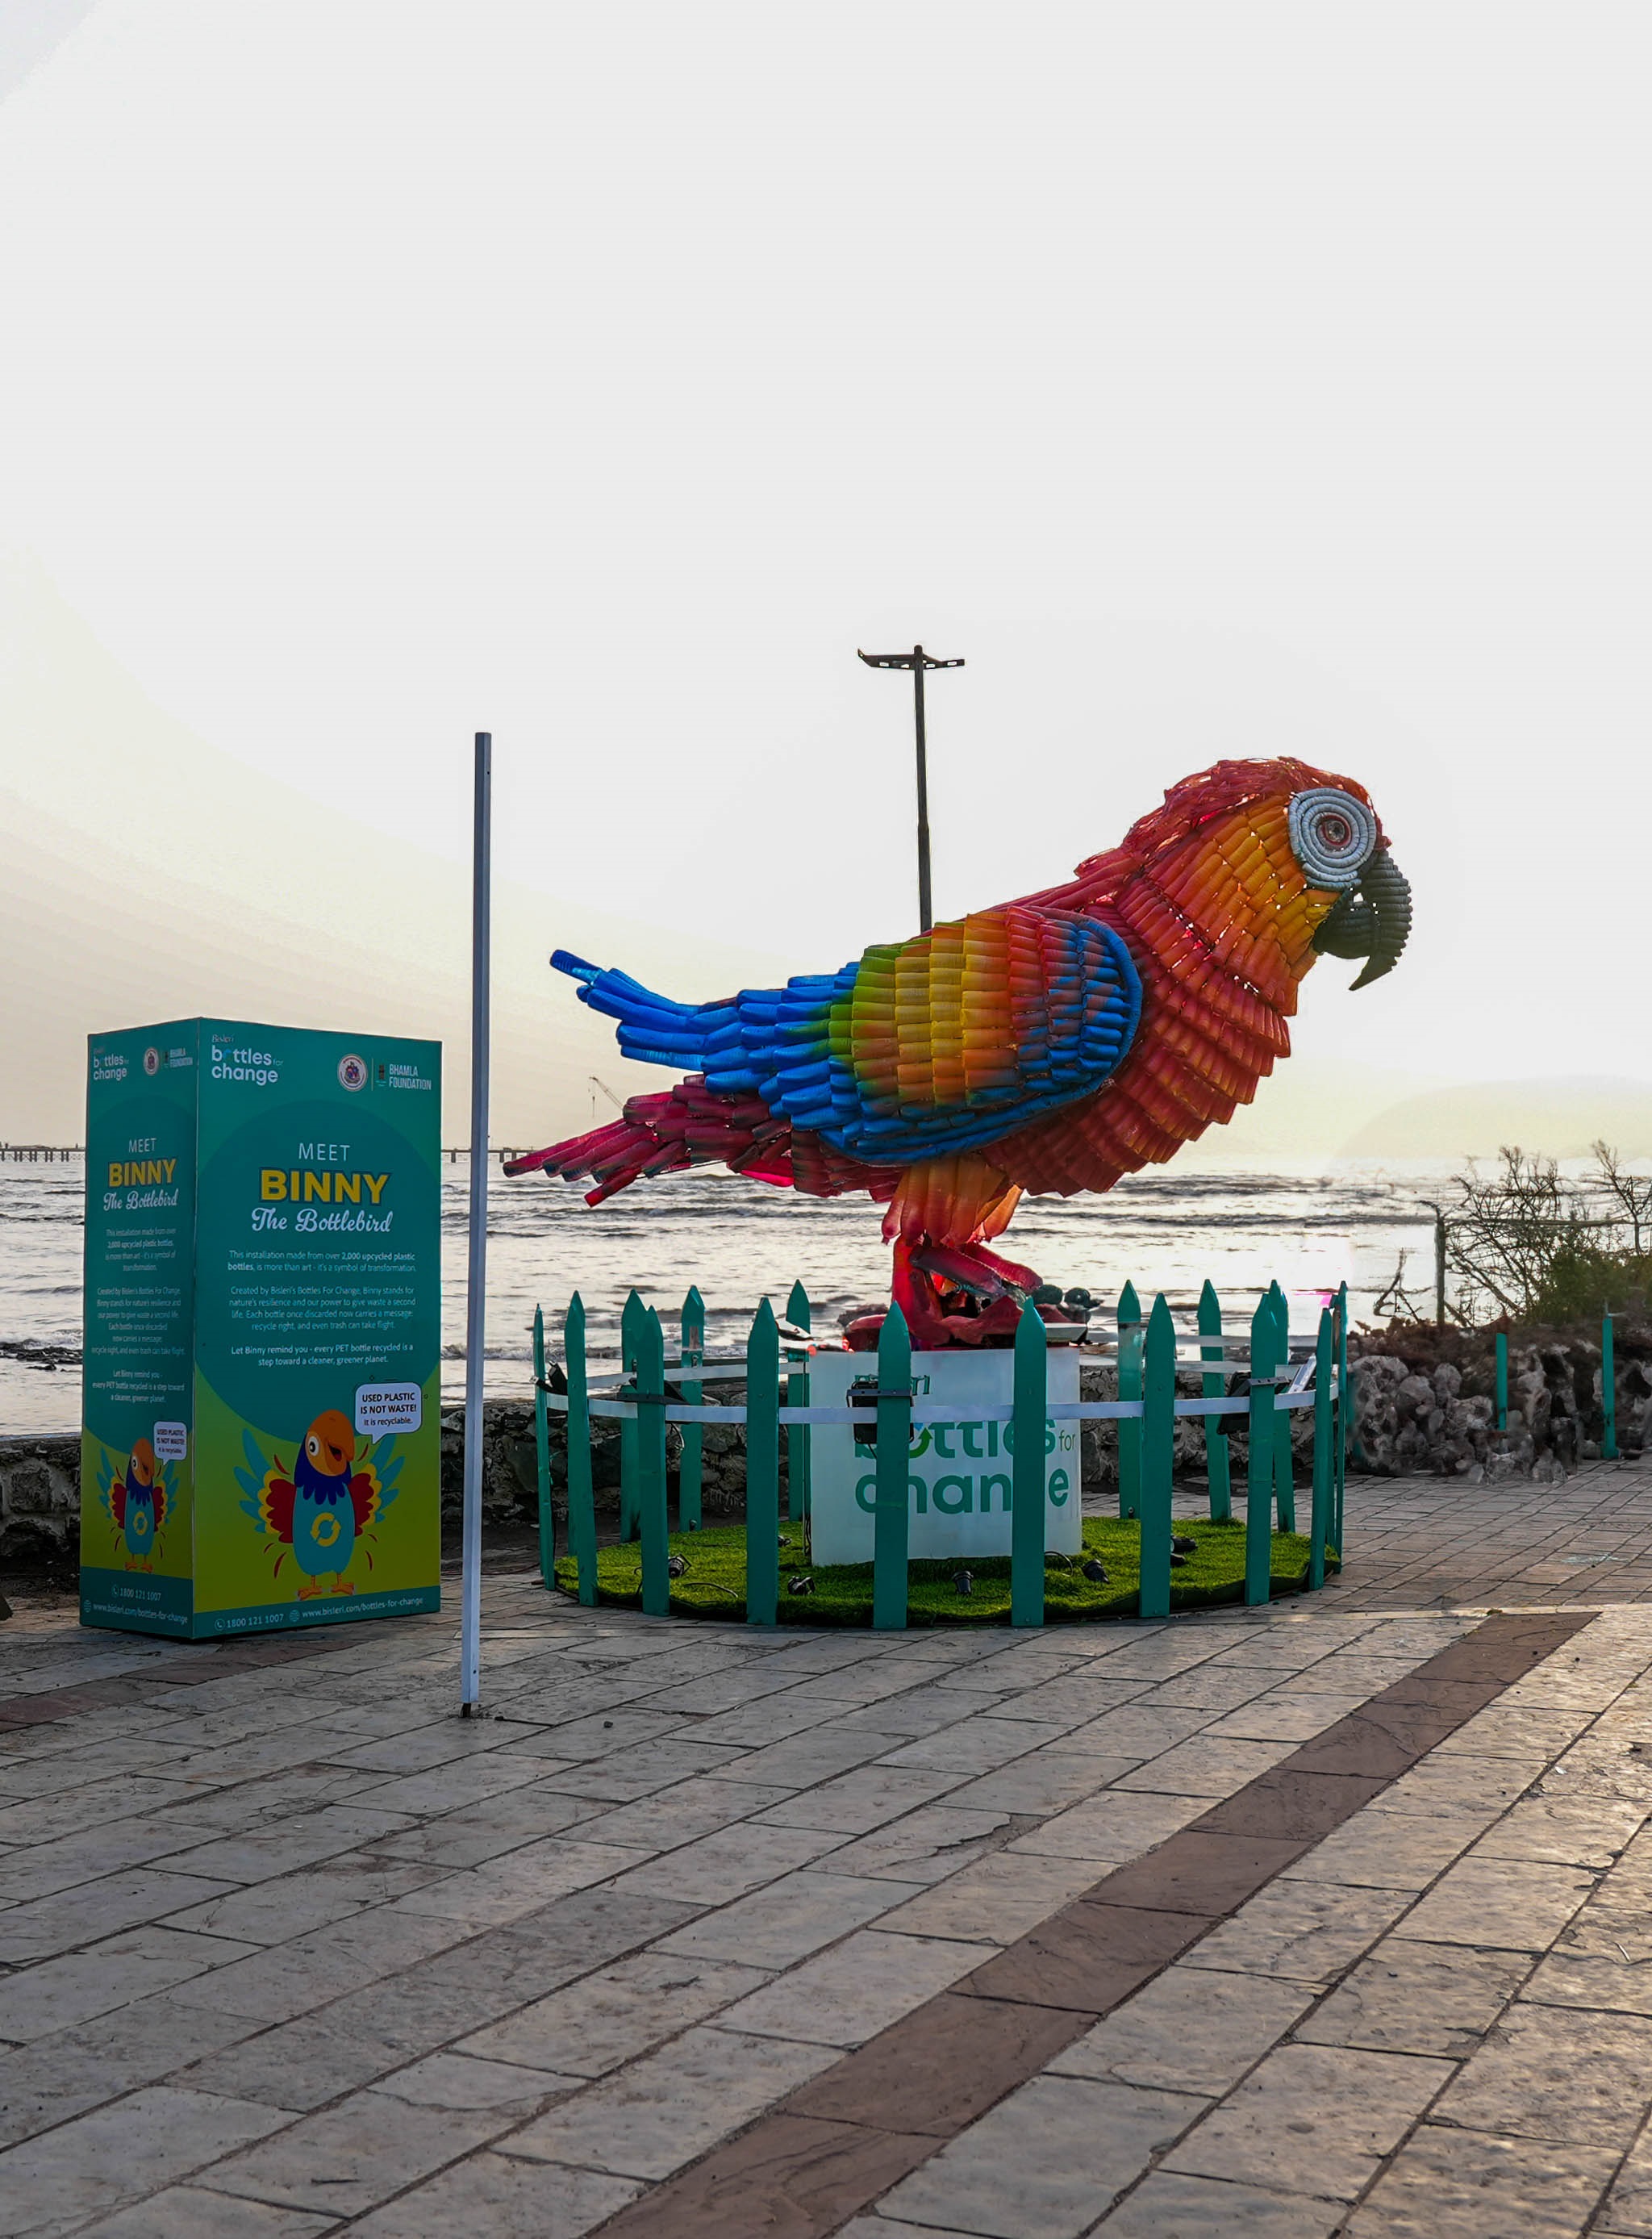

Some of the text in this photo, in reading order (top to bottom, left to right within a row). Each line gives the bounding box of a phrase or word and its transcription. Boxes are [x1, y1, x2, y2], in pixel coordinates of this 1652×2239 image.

[93, 1067, 127, 1081] change
[211, 1063, 279, 1086] change
[389, 1063, 419, 1077] BHAMLA
[389, 1076, 432, 1091] FOUNDATION
[128, 1138, 157, 1153] MEET
[298, 1142, 351, 1162] MEET
[108, 1158, 177, 1187] BINNY
[260, 1168, 390, 1205] BINNY
[103, 1188, 178, 1211] The Bottlebird
[252, 1207, 394, 1233] The Bottlebird
[228, 1250, 244, 1259] This
[286, 1251, 306, 1259] made
[307, 1251, 324, 1259] from
[362, 1251, 393, 1262] upcycled
[394, 1251, 415, 1262] plastic
[231, 1346, 244, 1355] Let
[244, 1345, 266, 1356] Binny
[267, 1344, 294, 1354] remind
[294, 1347, 309, 1356] you
[314, 1345, 334, 1355] every
[335, 1343, 349, 1353] PET
[350, 1343, 371, 1352] bottle
[373, 1343, 401, 1354] recycled
[258, 1358, 274, 1367] step
[275, 1356, 301, 1365] toward
[362, 1392, 415, 1402] USED PLASTIC
[361, 1403, 417, 1414] IS NOT WASTE!
[370, 1418, 377, 1426] is
[1058, 1429, 1076, 1452] for
[119, 1586, 135, 1598] 1800
[227, 1613, 285, 1628] 1800 121 1007
